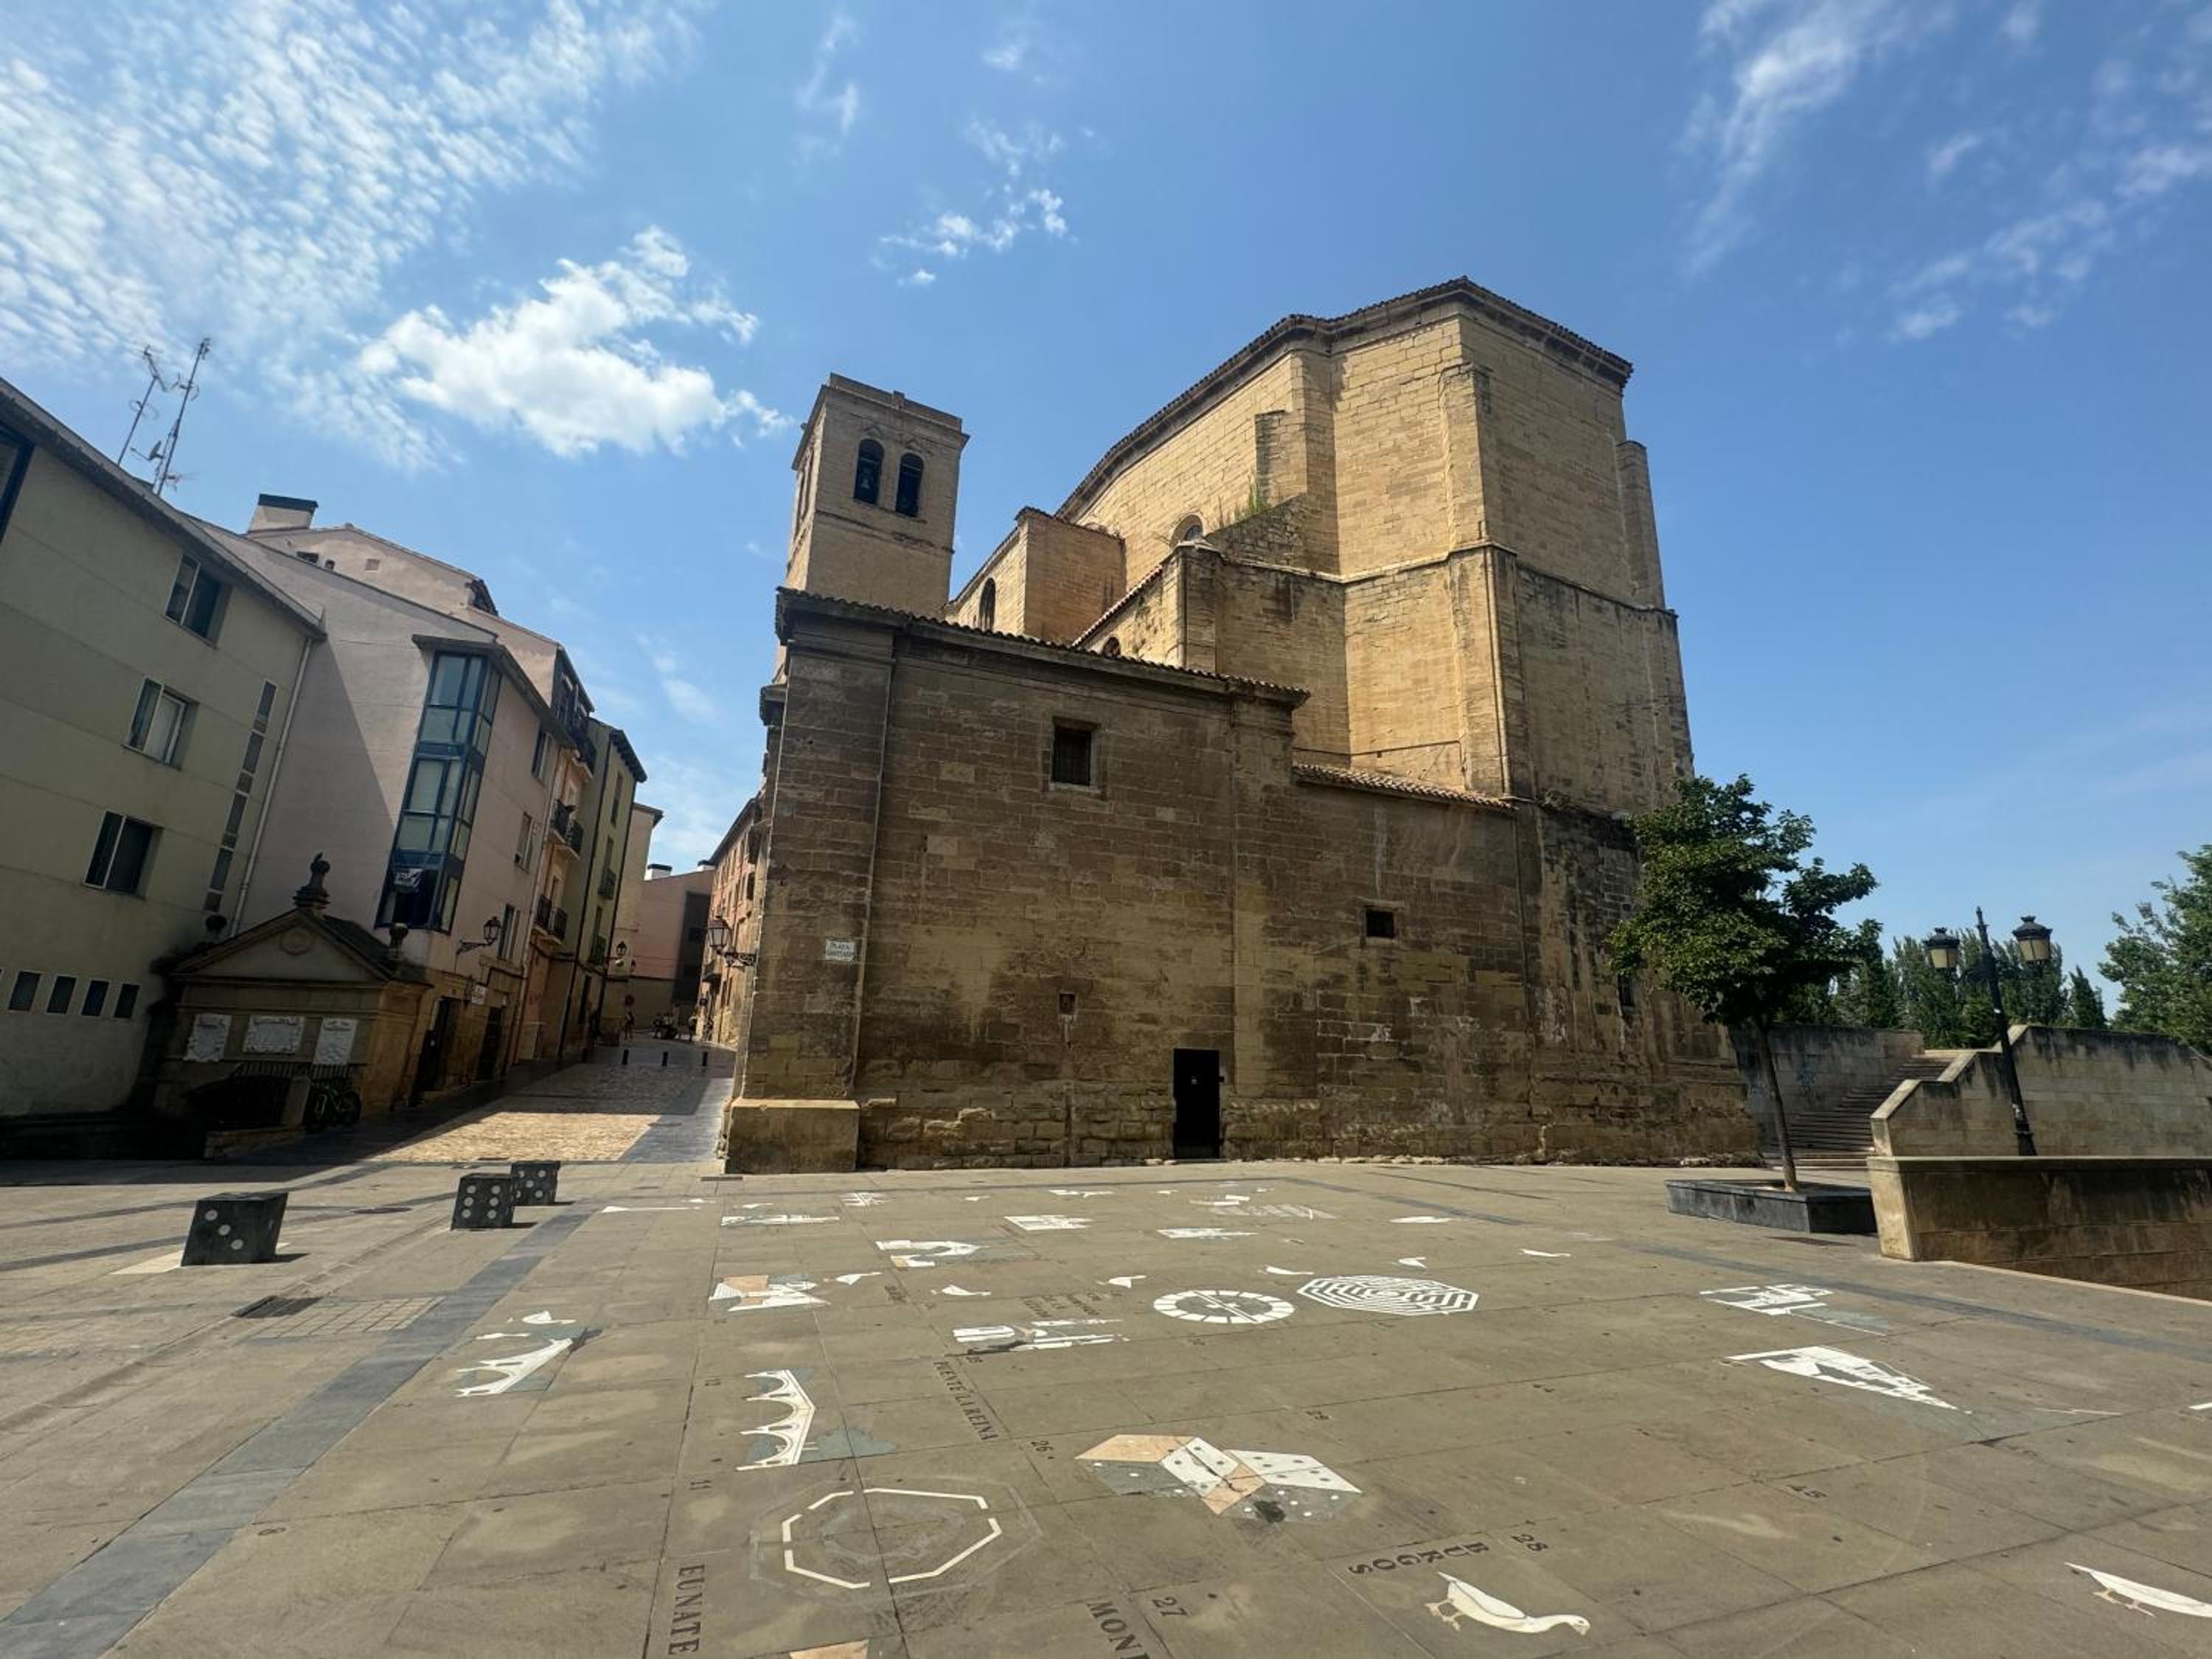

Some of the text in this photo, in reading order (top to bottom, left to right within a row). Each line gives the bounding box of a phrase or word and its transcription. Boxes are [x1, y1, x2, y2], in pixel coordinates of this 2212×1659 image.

[962, 1407, 999, 1441] REINA
[1031, 1439, 1054, 1453] 26
[1348, 1541, 1489, 1574] BURGOS
[1511, 1533, 1548, 1552] 28
[668, 1563, 705, 1655] EUNATE
[1152, 1596, 1189, 1617] 27
[1086, 1601, 1150, 1659] MON
